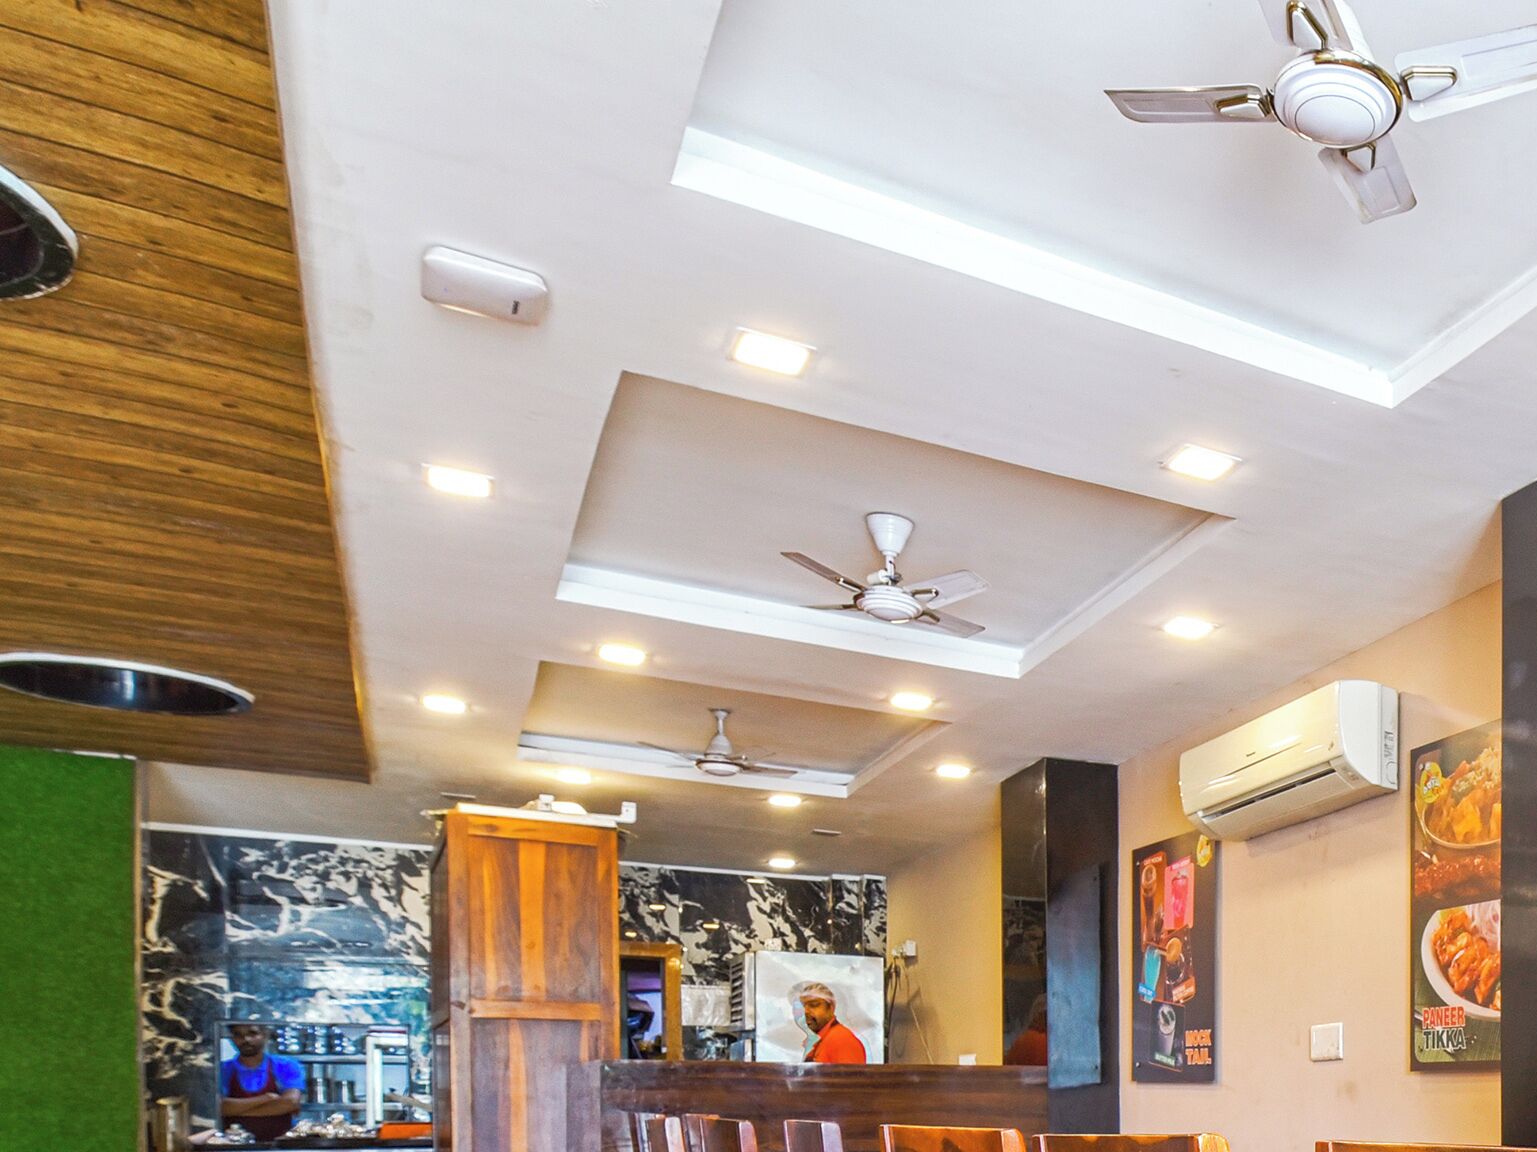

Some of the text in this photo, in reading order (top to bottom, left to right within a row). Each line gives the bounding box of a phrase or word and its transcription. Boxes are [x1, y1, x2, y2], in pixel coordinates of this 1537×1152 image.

[1422, 1005, 1466, 1030] PANEER
[1185, 1029, 1212, 1048] MOCK
[1423, 1027, 1467, 1051] TIKKA
[1185, 1047, 1212, 1066] TAIL
